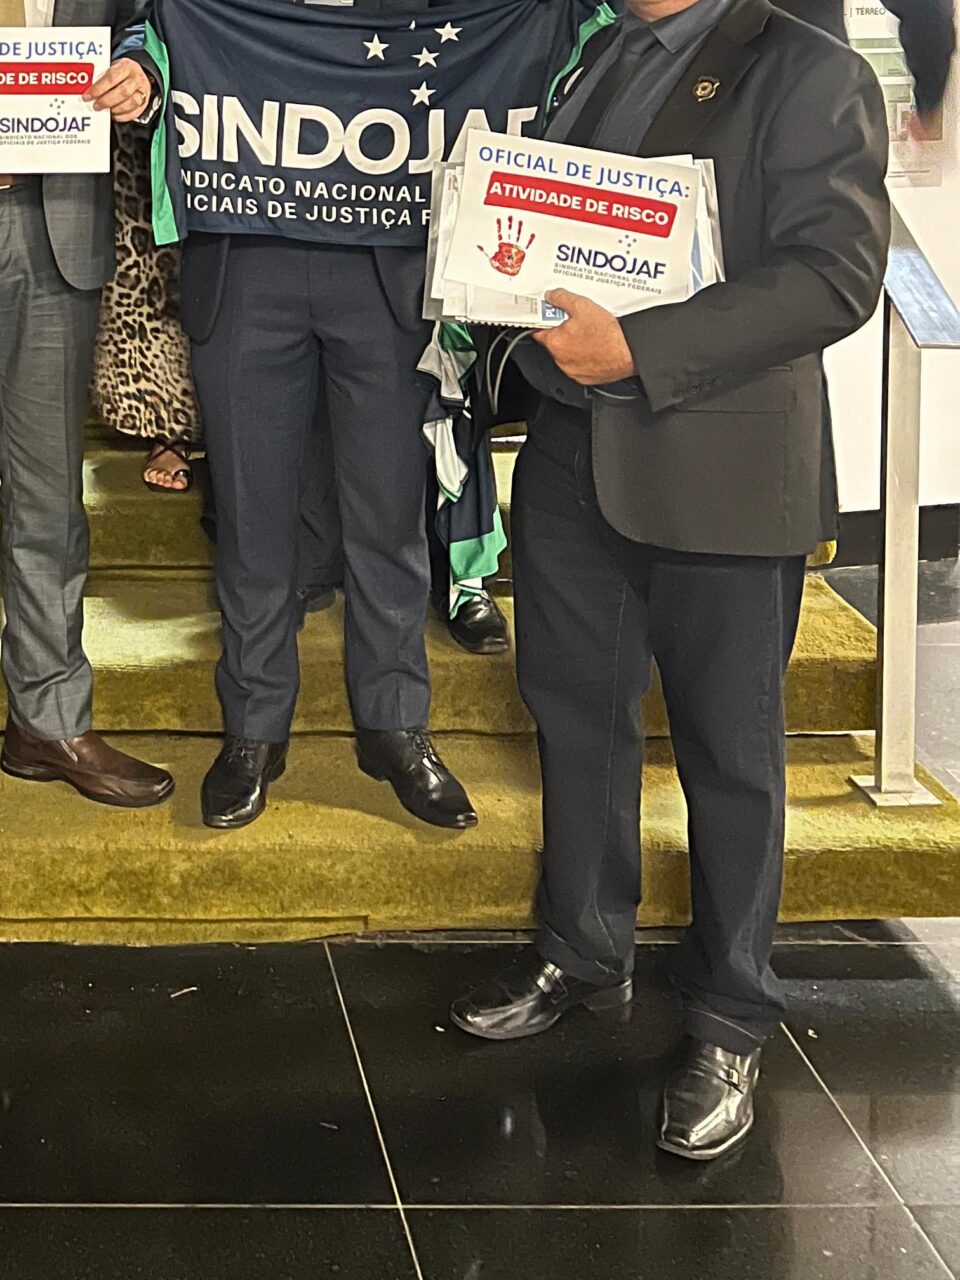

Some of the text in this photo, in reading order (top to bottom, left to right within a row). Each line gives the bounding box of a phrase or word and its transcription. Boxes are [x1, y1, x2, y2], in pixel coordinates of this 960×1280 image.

[25, 41, 103, 60] JUSTIÇA:
[18, 72, 39, 85] DE
[40, 71, 90, 85] RISCO
[180, 168, 285, 195] NDICATO
[294, 179, 427, 203] NACIONAL
[478, 146, 690, 202] OFICIAL DE JUSTIÇA:
[186, 193, 259, 216] ICIAIS
[267, 199, 298, 219] DE
[305, 204, 412, 230] JUSTIÇA
[489, 181, 670, 227] ATIVIDADE DE RISCO
[554, 262, 648, 286] SINDICATO NACIONAL DOS
[555, 243, 667, 280] SINDOJAF
[552, 268, 584, 279] OFICIAIS
[584, 274, 595, 282] DE
[627, 281, 663, 295] FEDERAIS
